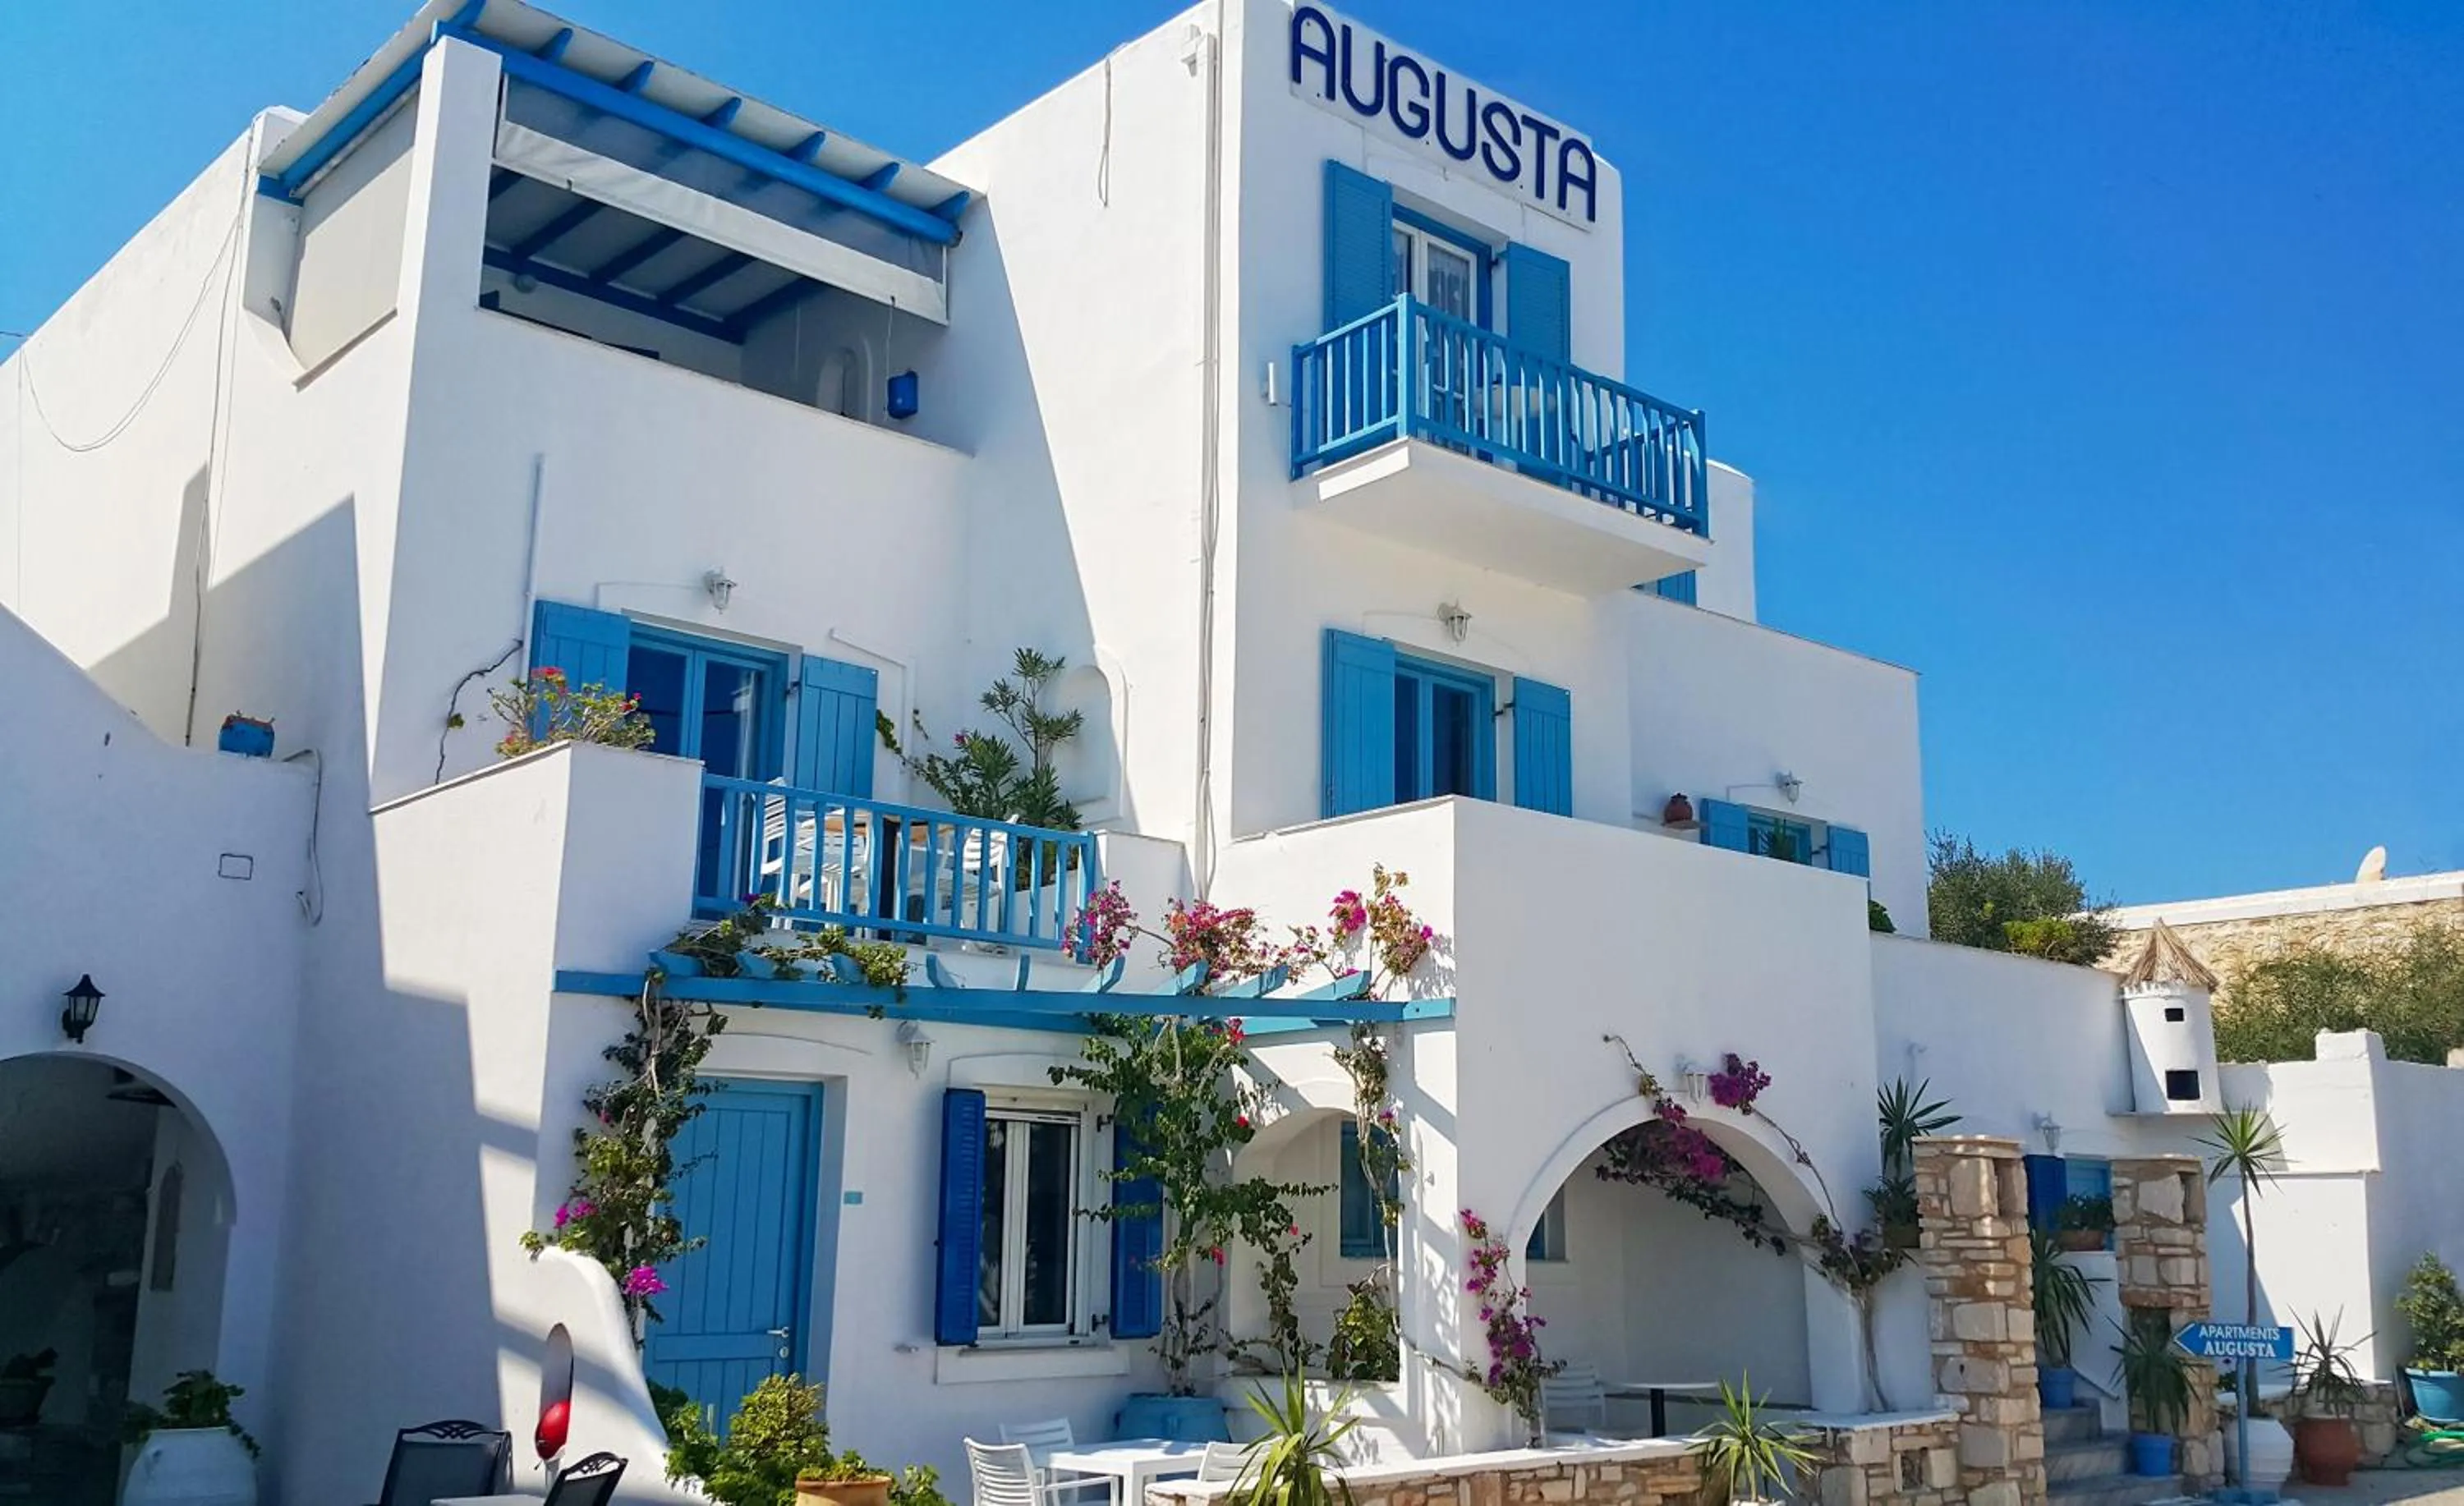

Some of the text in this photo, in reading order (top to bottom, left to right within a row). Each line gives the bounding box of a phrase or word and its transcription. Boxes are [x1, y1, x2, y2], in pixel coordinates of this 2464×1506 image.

[1292, 7, 1596, 223] AUGUSTA
[2199, 1325, 2280, 1341] APARTMENTS
[2204, 1341, 2276, 1357] AUGUSTA
